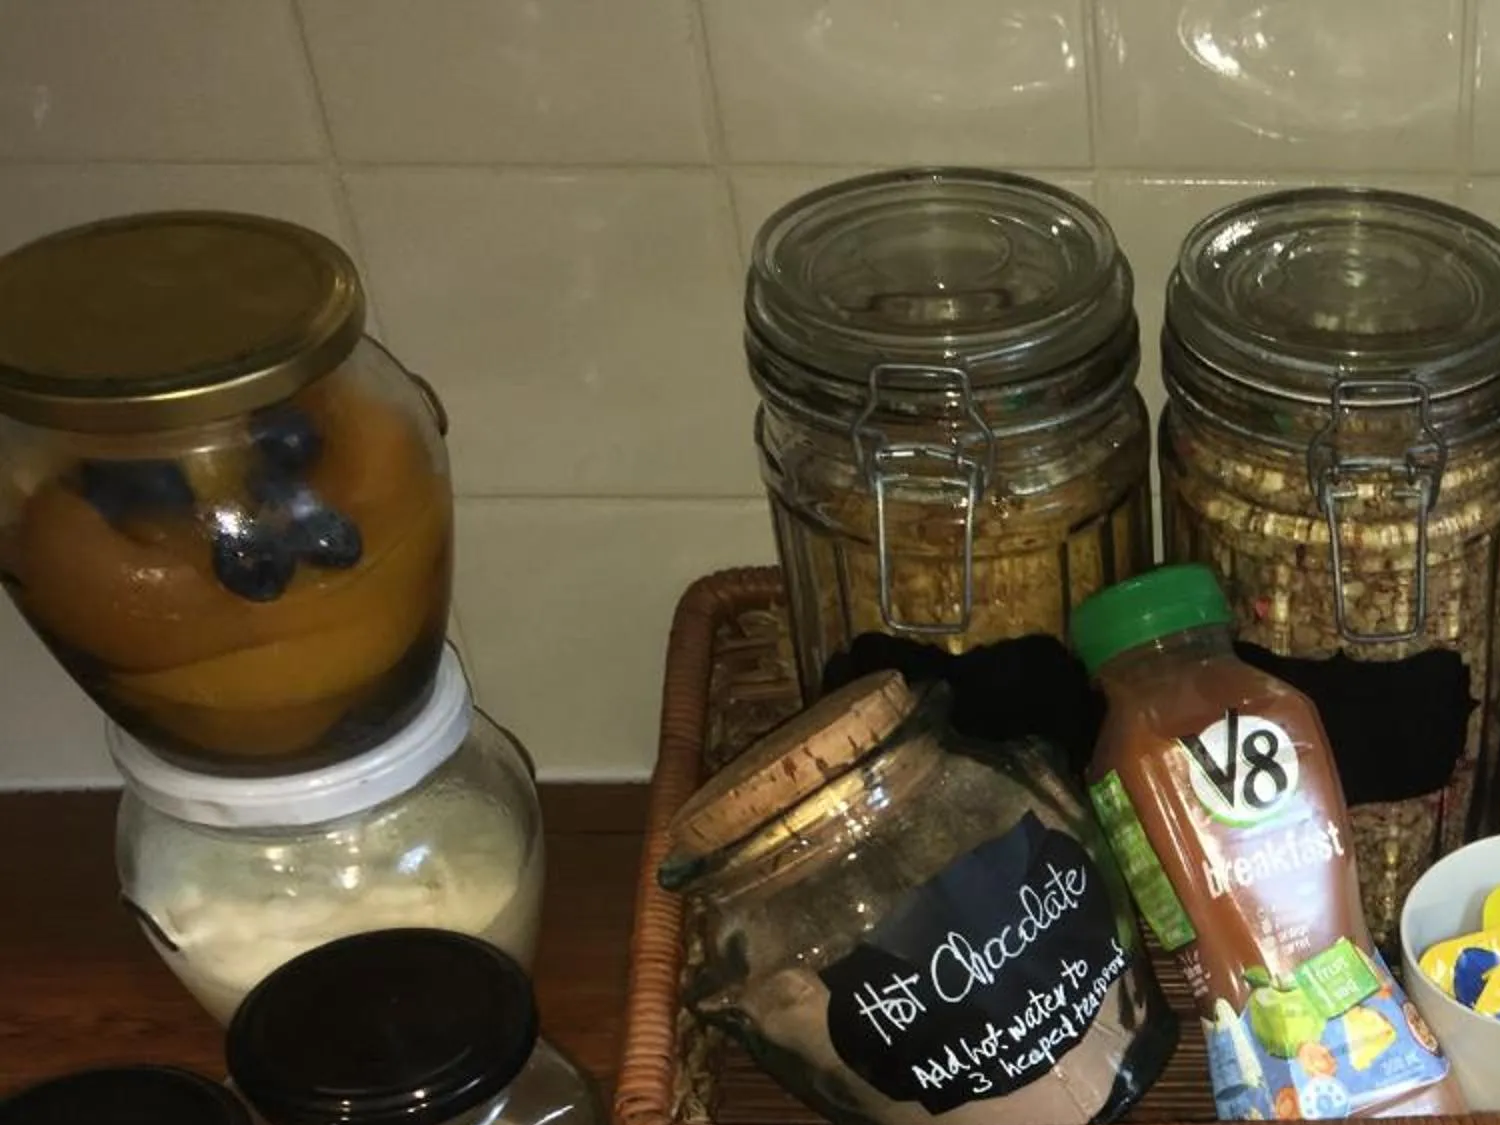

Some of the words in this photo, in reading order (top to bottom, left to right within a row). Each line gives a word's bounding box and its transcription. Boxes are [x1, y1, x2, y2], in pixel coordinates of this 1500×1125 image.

[1177, 708, 1288, 809] V8
[853, 972, 927, 1046] Hot
[931, 864, 1087, 1002] Chocolate
[912, 1045, 970, 1089] Add
[1008, 984, 1068, 1041] water
[1061, 959, 1088, 989] to
[968, 1072, 993, 1093] 3
[999, 1014, 1078, 1077] heaped
